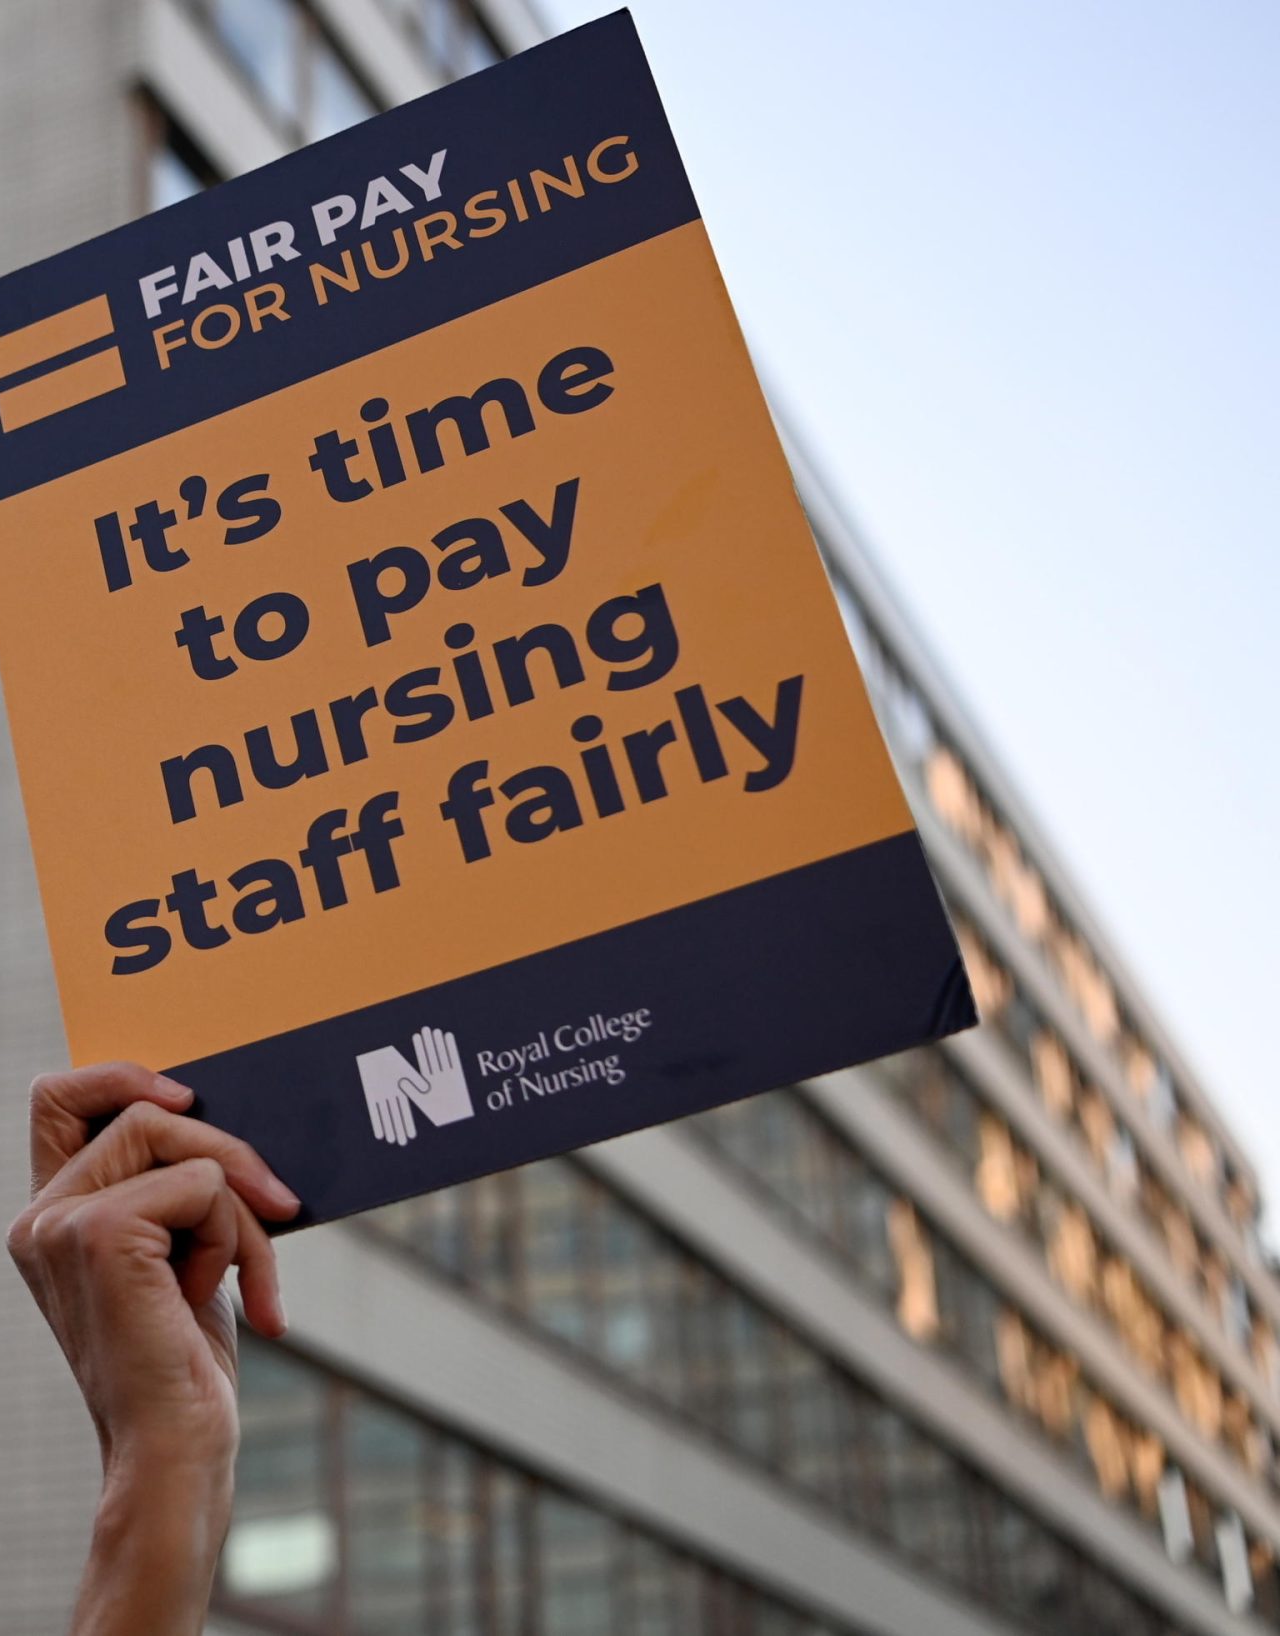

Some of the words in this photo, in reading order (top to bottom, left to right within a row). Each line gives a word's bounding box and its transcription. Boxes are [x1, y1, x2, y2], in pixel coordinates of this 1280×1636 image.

[138, 220, 302, 320] FAIR
[312, 148, 448, 248] PAY
[152, 282, 292, 371] FOR
[308, 135, 641, 307] NURSING
[93, 474, 282, 593] It's
[308, 346, 616, 504] time
[174, 592, 310, 682] to
[346, 477, 580, 648] pay
[159, 582, 680, 825] nursing
[104, 790, 406, 976] staff
[439, 674, 805, 865] fairly
[476, 1031, 551, 1077] Royal
[553, 1007, 652, 1052] College
[486, 1080, 513, 1112] of
[519, 1054, 626, 1102] Nursing
